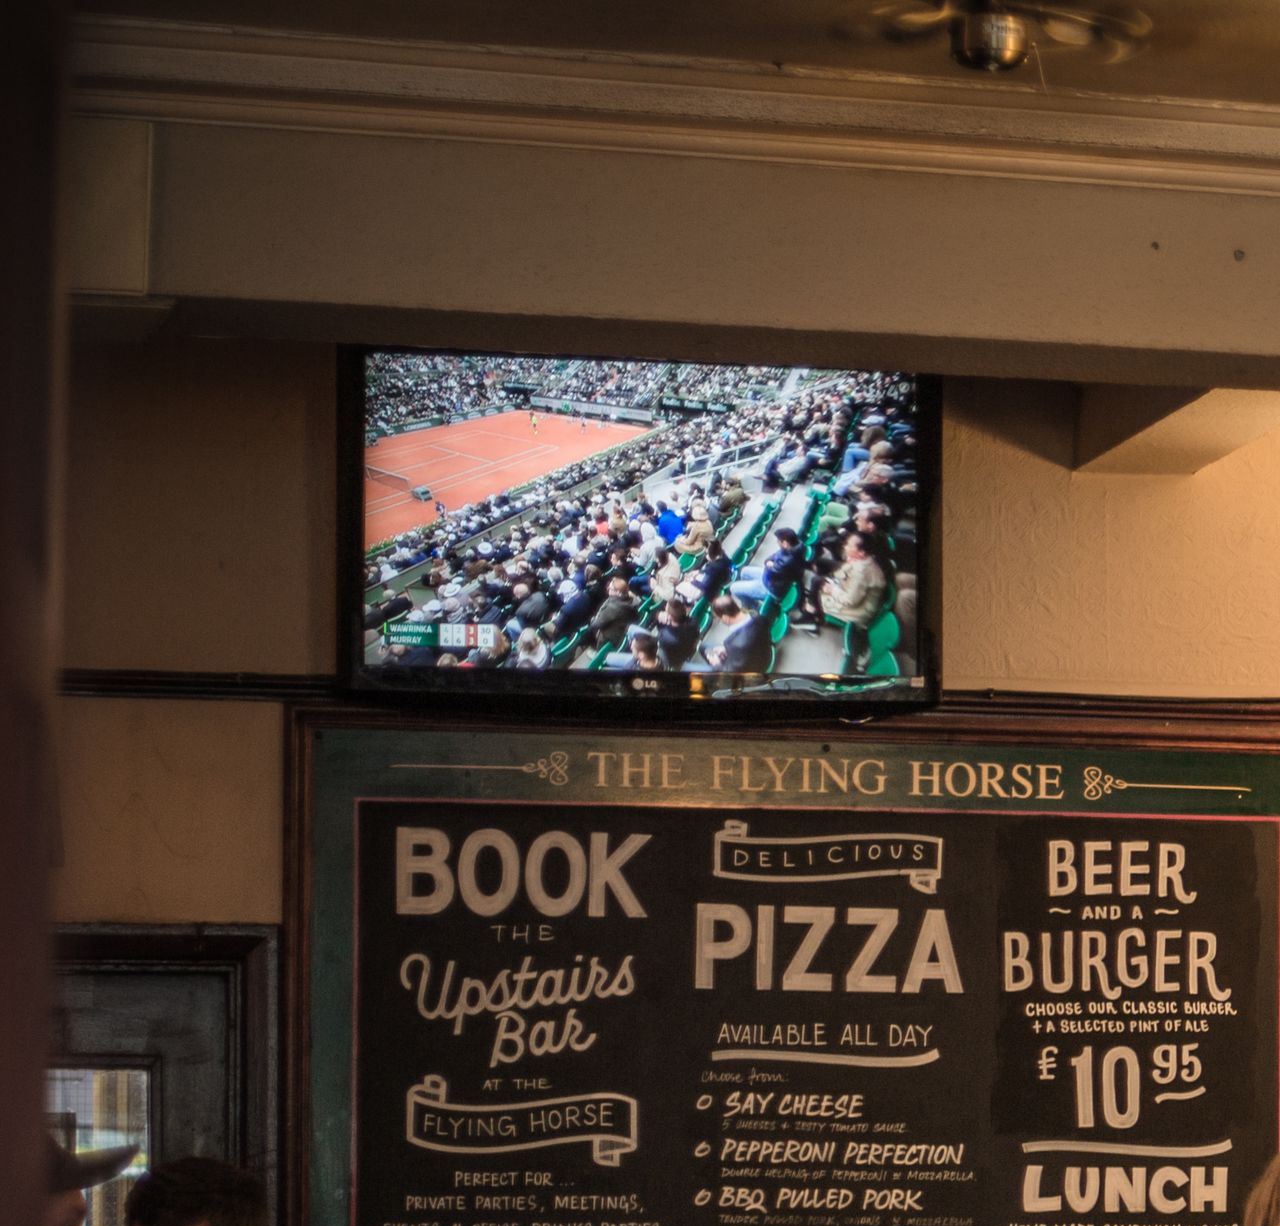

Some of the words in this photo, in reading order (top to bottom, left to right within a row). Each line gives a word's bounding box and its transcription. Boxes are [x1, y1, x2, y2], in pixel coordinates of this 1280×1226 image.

[389, 625, 433, 633] WAWRINKA
[389, 636, 422, 644] MURRAY
[587, 751, 688, 789] THE
[709, 755, 888, 795] FLYING
[908, 761, 1065, 800] HORSE
[733, 844, 925, 867] DELICIOUS
[396, 826, 653, 918] BOOK
[1049, 840, 1198, 904] BEER
[1082, 905, 1122, 920] AND
[1131, 905, 1144, 920] A
[490, 924, 555, 943] THE
[695, 903, 964, 994] PIZZA
[1004, 927, 1232, 1001] BURGER
[400, 953, 636, 1036] Upstairs
[1025, 1002, 1083, 1016] CHOOSE
[1089, 1002, 1118, 1015] OUR
[1122, 1002, 1178, 1015] CLASSIC
[1184, 1002, 1238, 1016] BURGER
[489, 1008, 597, 1068] Bar
[717, 1023, 828, 1046] AVAILABLE
[840, 1023, 879, 1046] ALL
[889, 1024, 933, 1048] DAY
[1046, 1021, 1056, 1033] A
[1060, 1019, 1125, 1033] SELECTED
[1130, 1020, 1159, 1033] PINT
[1164, 1019, 1181, 1033] OF
[1185, 1019, 1210, 1033] ALE
[482, 1079, 503, 1090] AT
[513, 1078, 553, 1090] THE
[723, 1091, 775, 1118] SAY
[778, 1094, 864, 1120] CHEESE
[424, 1113, 517, 1139] FLYING
[529, 1103, 615, 1132] HORSE
[830, 1122, 869, 1133] TOMATO
[872, 1122, 907, 1133] SAUCE
[720, 1138, 836, 1163] PEPPERONI
[843, 1142, 965, 1166] PERFECTION
[455, 1171, 519, 1187] PERFECT
[525, 1171, 553, 1187] FOR
[721, 1166, 761, 1178] DOUBLE
[764, 1168, 809, 1182] HELPING
[812, 1169, 826, 1180] OF
[831, 1169, 888, 1181] PEPPERONI
[719, 1186, 768, 1214] BBQ
[775, 1187, 854, 1210] PULLED
[862, 1188, 924, 1211] PORK
[1022, 1165, 1229, 1214] LUNCH
[405, 1195, 467, 1211] PRIVATE
[475, 1195, 545, 1213] PARTIES,
[554, 1194, 645, 1213] MEETINGS,
